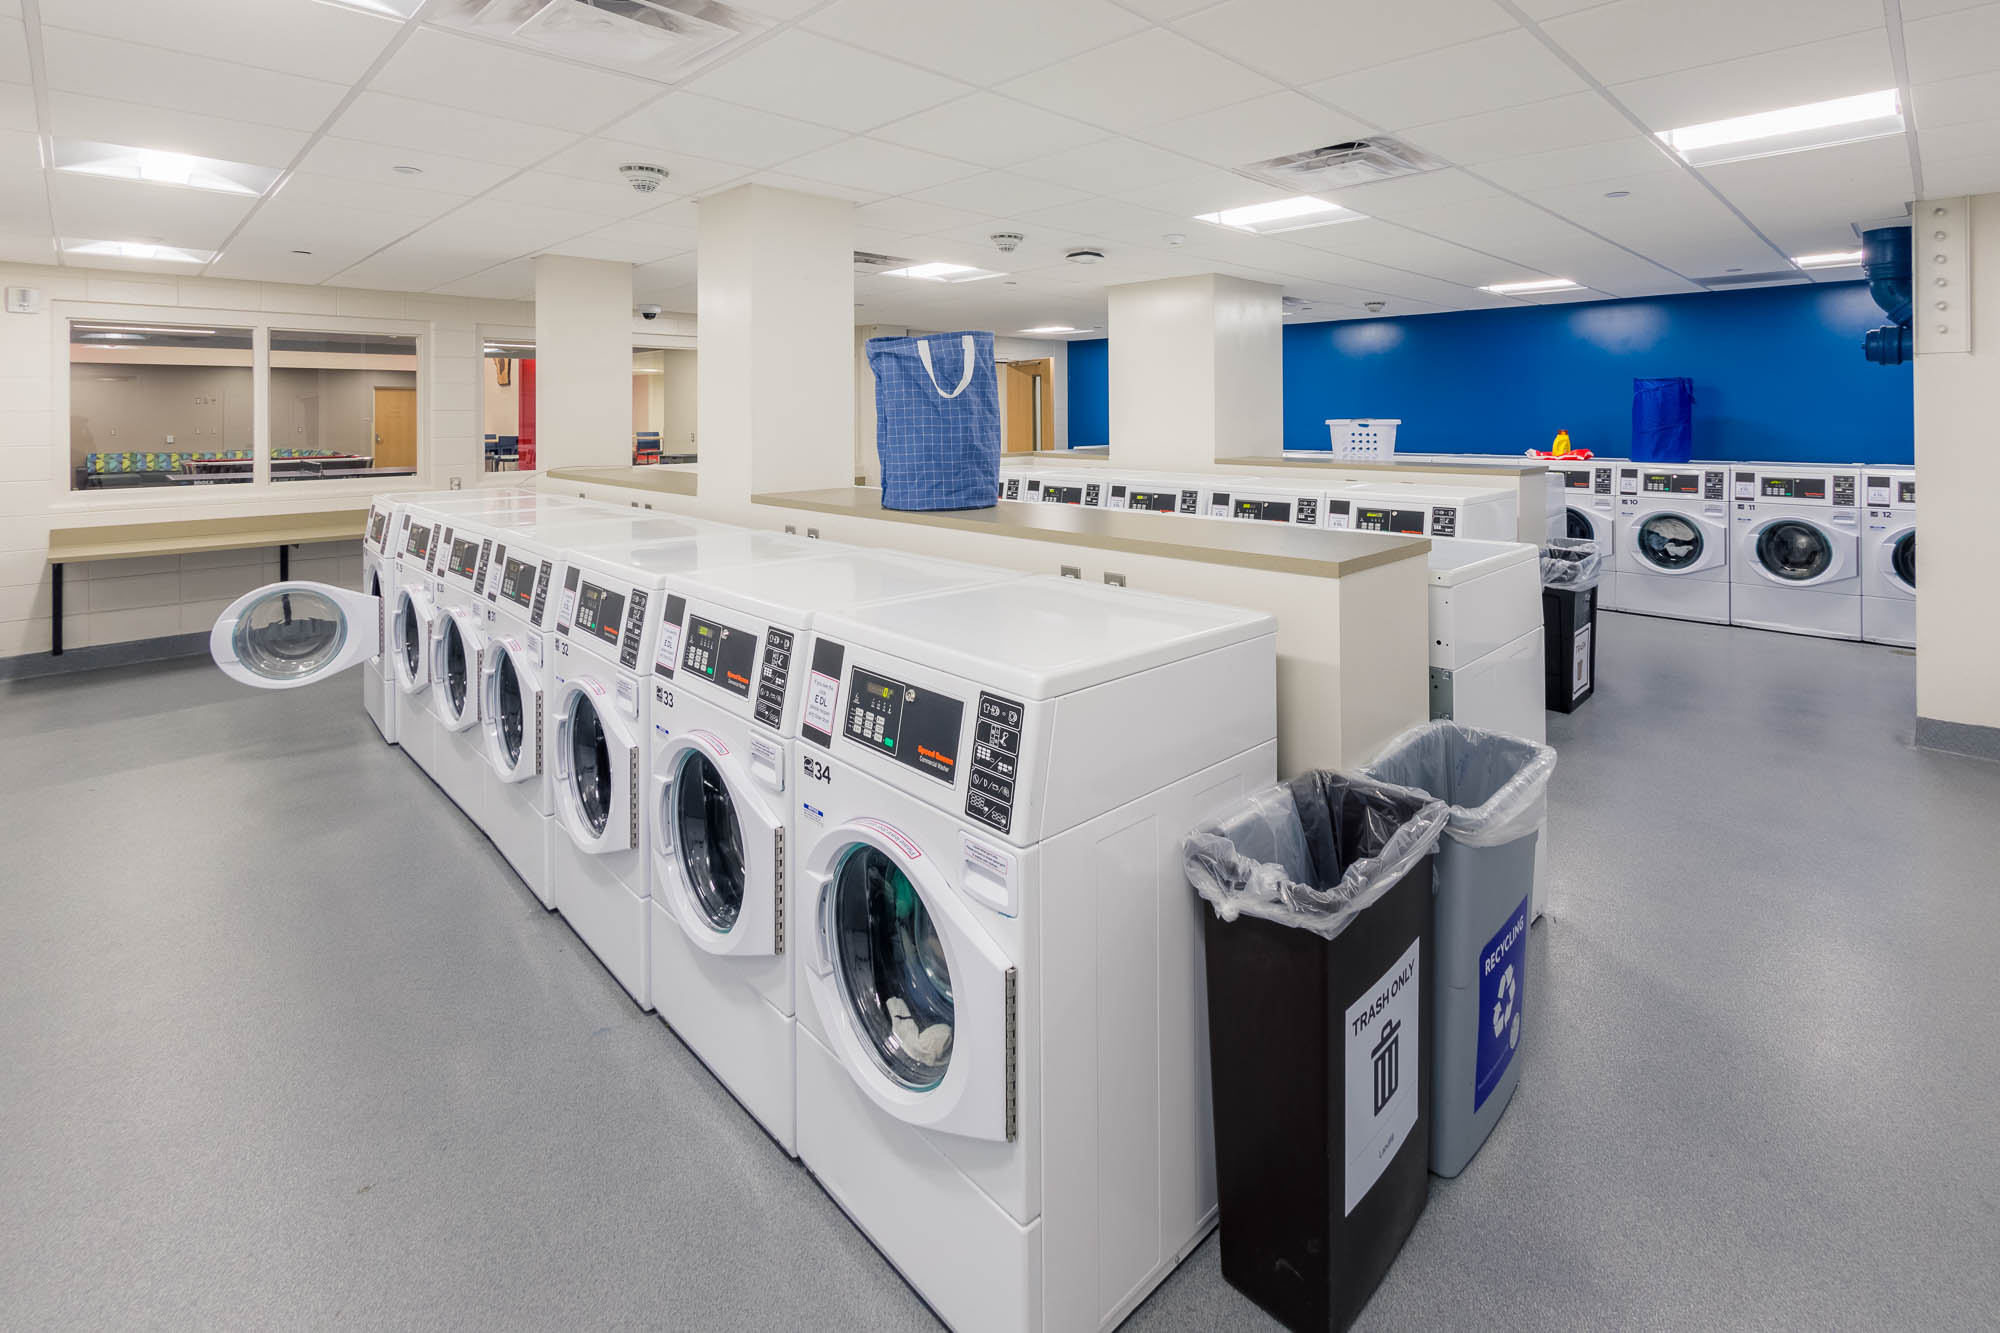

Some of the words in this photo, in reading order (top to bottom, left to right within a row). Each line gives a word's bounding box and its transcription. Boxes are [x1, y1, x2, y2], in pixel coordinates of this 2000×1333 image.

[561, 642, 569, 656] 32
[663, 690, 674, 708] 33
[815, 694, 828, 708] EDL
[815, 761, 832, 784] 34
[1484, 914, 1524, 976] RECYCLING
[1352, 987, 1390, 1037] TRASH
[1391, 958, 1415, 998] ONLY
